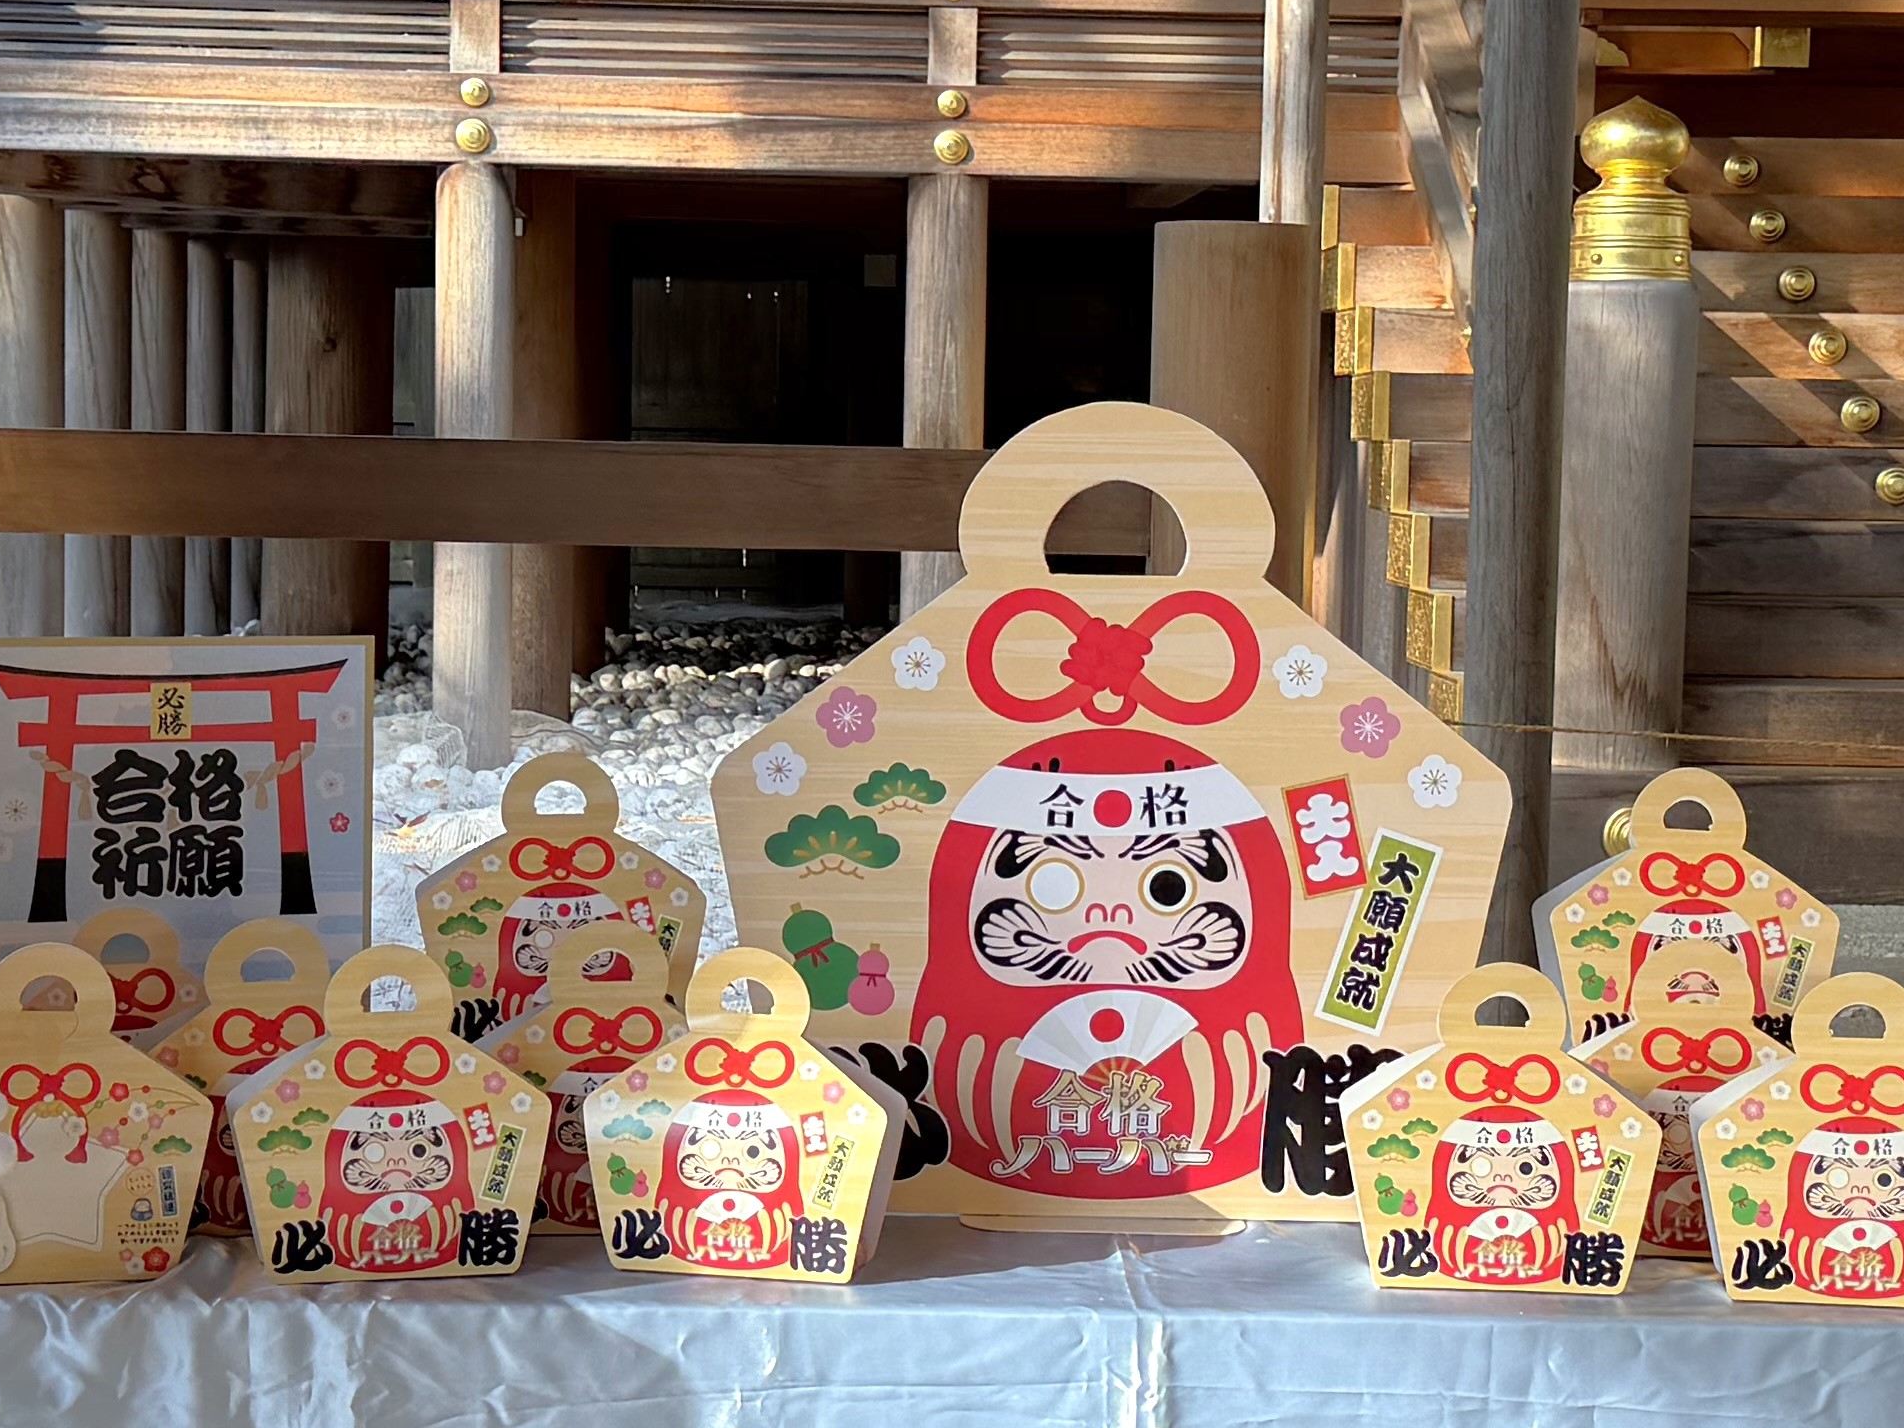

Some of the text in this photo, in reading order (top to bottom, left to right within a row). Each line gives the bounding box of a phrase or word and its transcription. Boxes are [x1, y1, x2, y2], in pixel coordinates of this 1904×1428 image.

[157, 687, 187, 736] 必勝
[91, 748, 245, 824] 合格
[1039, 783, 1189, 828] 合格
[1296, 793, 1359, 882] 大入
[92, 825, 245, 900] 祈願
[538, 900, 592, 919] 合格
[1669, 918, 1723, 935] 合格
[659, 923, 676, 952] 大願
[1335, 852, 1420, 1012] 大願成就
[1762, 921, 1785, 954] 大入
[1778, 943, 1807, 1001] 大願成就
[367, 1109, 427, 1129] 合格
[708, 1109, 763, 1127] 合格
[1032, 1069, 1172, 1137] 合格
[468, 1108, 494, 1146] 大入
[802, 1115, 827, 1153] 大入
[1476, 1126, 1533, 1144] 合格
[487, 1132, 517, 1194] 大願成就
[989, 1135, 1213, 1177] ハーバー
[1575, 1131, 1602, 1168] 大入
[1832, 1138, 1892, 1155] 合格
[817, 1142, 850, 1204] 大願成就
[1595, 1155, 1626, 1218] 大願成就
[272, 1208, 519, 1273] 必 勝
[368, 1224, 424, 1250] 合格
[613, 1208, 847, 1274] 必 勝
[701, 1222, 755, 1248] 合格
[1471, 1240, 1528, 1265] 合格
[350, 1248, 439, 1268] ハーバー
[687, 1246, 771, 1263] ハーバー
[1378, 1228, 1624, 1286] 必 勝
[1455, 1263, 1543, 1279] ハーバー
[1732, 1239, 1793, 1290] 必
[1829, 1251, 1885, 1276] 合格
[1810, 1274, 1901, 1292] ハーバー
